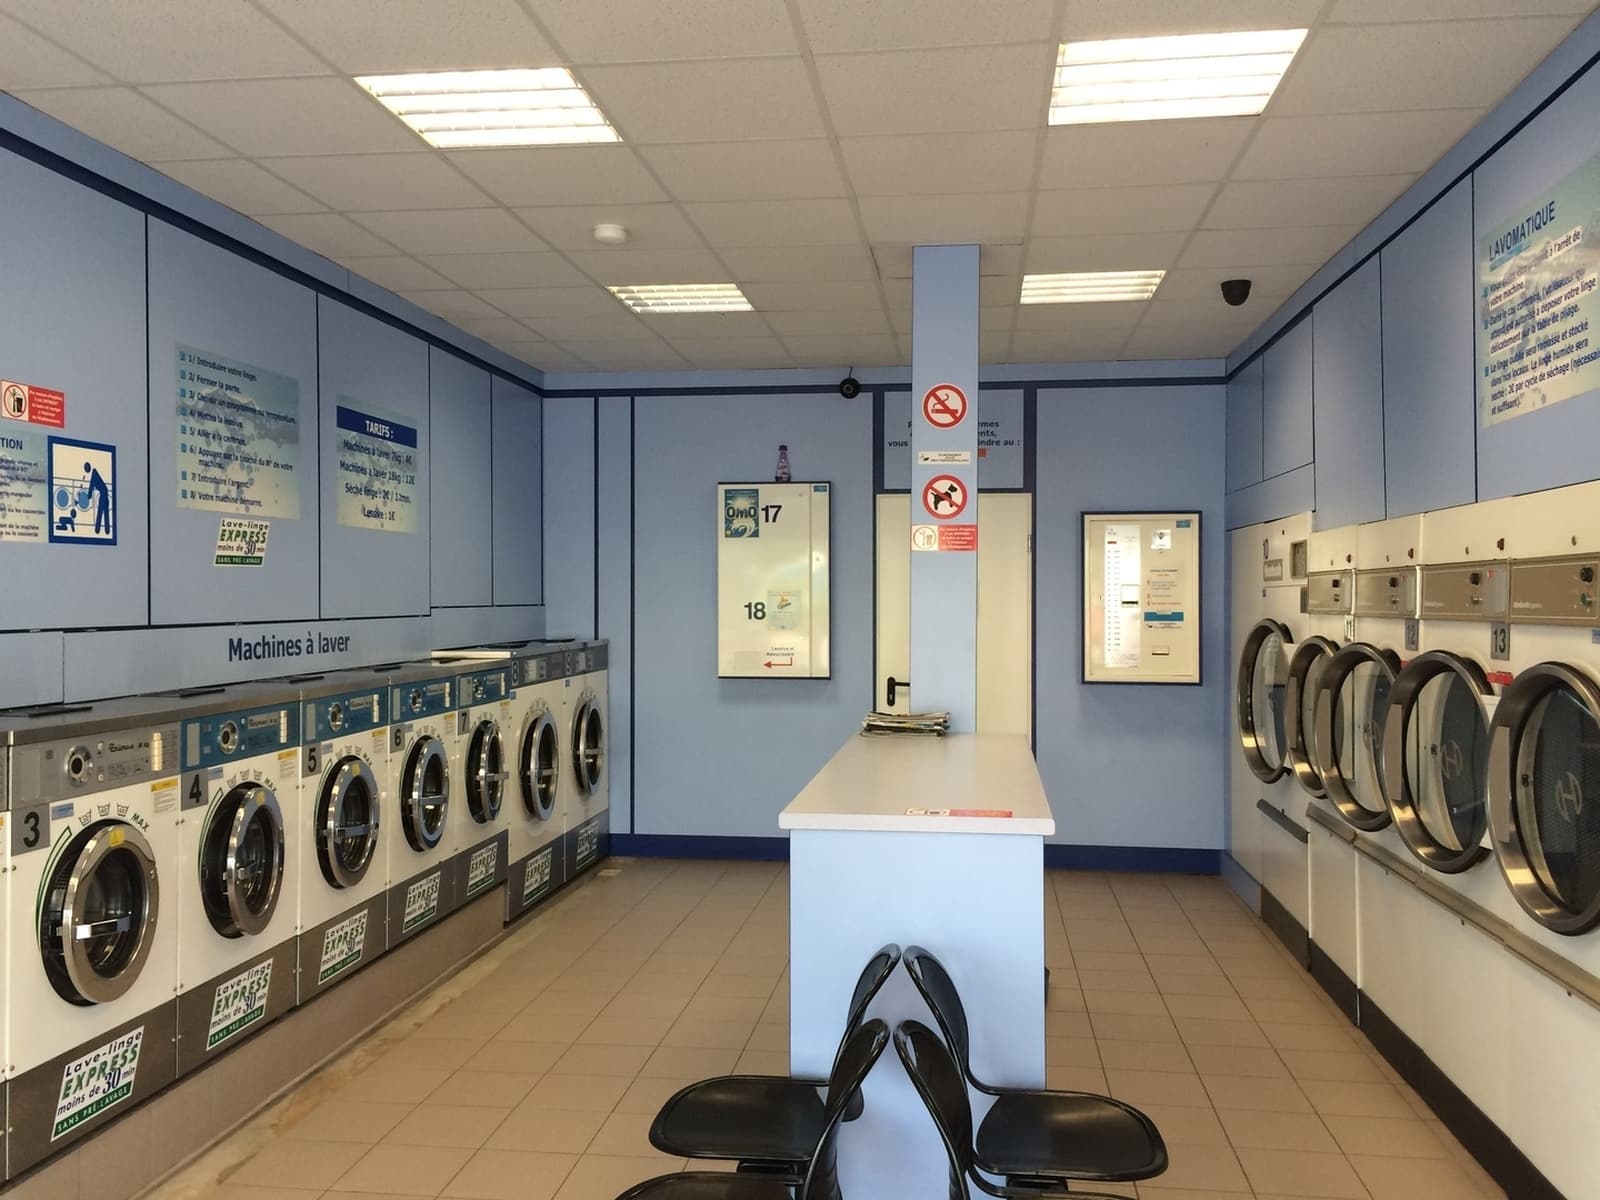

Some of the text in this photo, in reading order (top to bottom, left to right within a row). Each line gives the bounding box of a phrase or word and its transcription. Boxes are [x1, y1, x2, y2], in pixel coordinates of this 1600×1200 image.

[1489, 200, 1555, 261] LAVOMATIQUE
[1563, 286, 1579, 299] votre
[1580, 277, 1595, 293] linge
[1575, 337, 1587, 349] sera
[1491, 363, 1495, 372] Le
[1515, 380, 1523, 393] par
[365, 420, 390, 438] TARIFS
[343, 438, 370, 454] Machines
[392, 451, 401, 464] 7kg
[340, 459, 367, 475] Machines
[373, 467, 387, 479] laver
[388, 470, 401, 483] 18kg
[388, 510, 396, 520] 1€
[727, 506, 757, 519] OMO
[761, 505, 782, 523] 17
[222, 519, 268, 530] Lave-linge
[220, 529, 266, 544] EXPRESS
[244, 541, 256, 555] 30
[743, 601, 766, 620] 18
[1407, 622, 1416, 645] 12
[1494, 628, 1506, 653] 13
[228, 631, 350, 662] Machines à laver
[513, 662, 518, 683] 8
[462, 712, 468, 732] 7
[394, 729, 402, 746] 6
[308, 747, 317, 772] 5
[189, 774, 202, 803] 4
[23, 811, 40, 847] 3
[131, 812, 150, 832] MAX
[471, 851, 496, 873] EXPRESS
[527, 858, 550, 882] EXPRESS
[408, 882, 438, 908] EXPRESS
[325, 922, 365, 955] EXPRESS
[217, 963, 271, 997] Lave-linge
[214, 972, 269, 1016] EXPRESS
[233, 1005, 242, 1017] de
[243, 992, 256, 1014] 30
[66, 1032, 142, 1077] Lave-linge
[61, 1043, 139, 1100] EXPRESS
[58, 1067, 135, 1115] moins de 30 min
[57, 1114, 79, 1132] SANS
